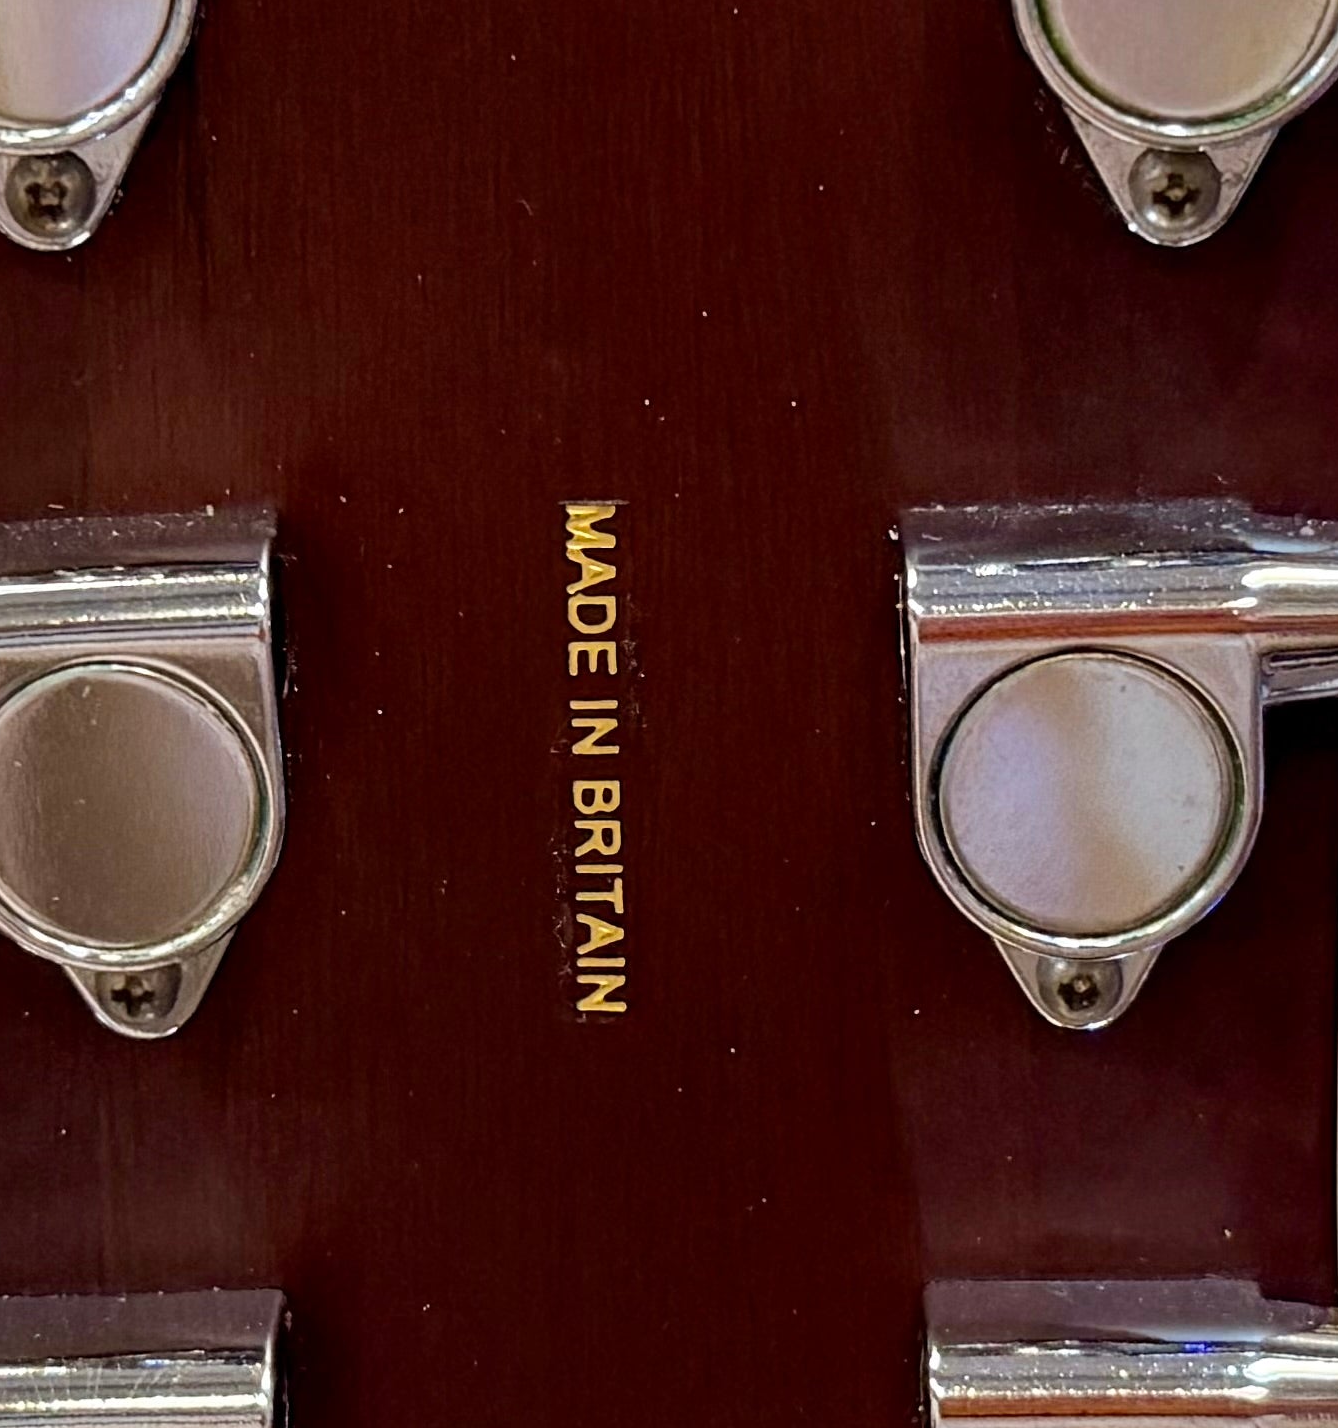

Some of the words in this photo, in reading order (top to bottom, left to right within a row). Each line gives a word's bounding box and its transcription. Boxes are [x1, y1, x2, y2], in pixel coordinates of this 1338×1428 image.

[566, 504, 617, 676] MADE
[570, 700, 620, 755] IN
[573, 780, 627, 1013] BRITAIN
